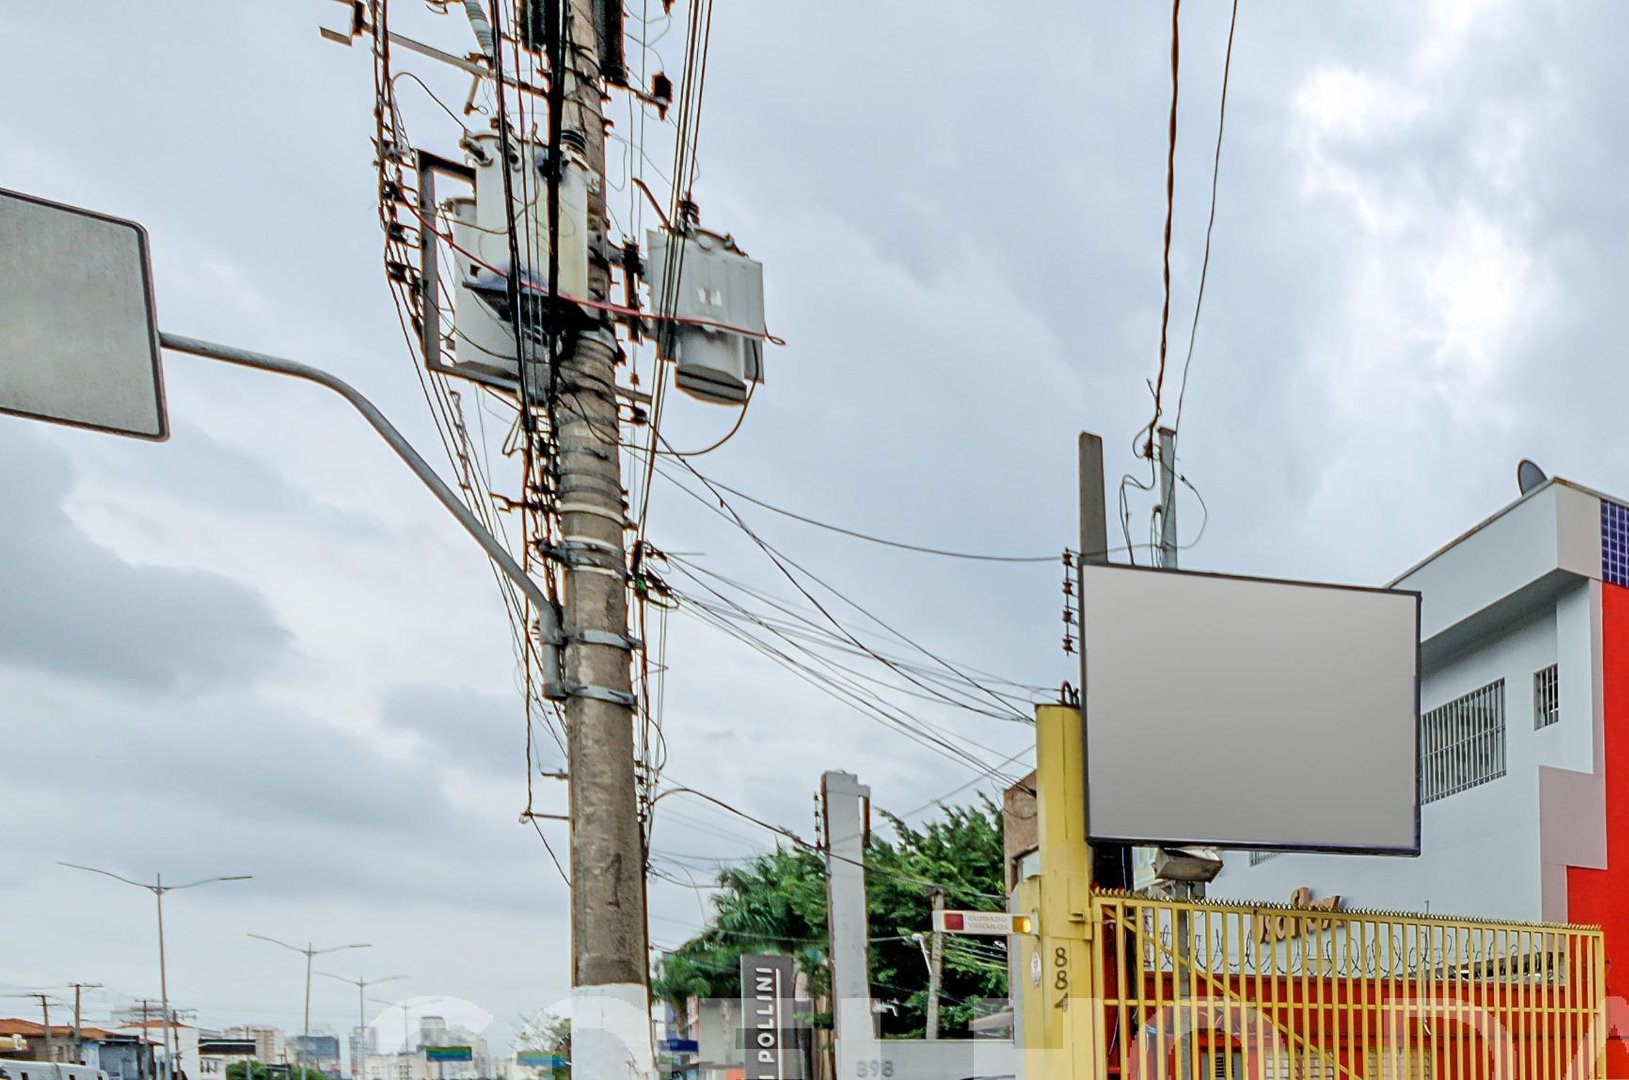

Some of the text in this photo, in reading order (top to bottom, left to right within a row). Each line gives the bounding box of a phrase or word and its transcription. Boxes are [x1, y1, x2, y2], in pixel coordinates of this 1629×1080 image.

[1054, 946, 1069, 1012] 884
[755, 966, 776, 1063] POLLINI
[856, 1060, 895, 1079] 898
